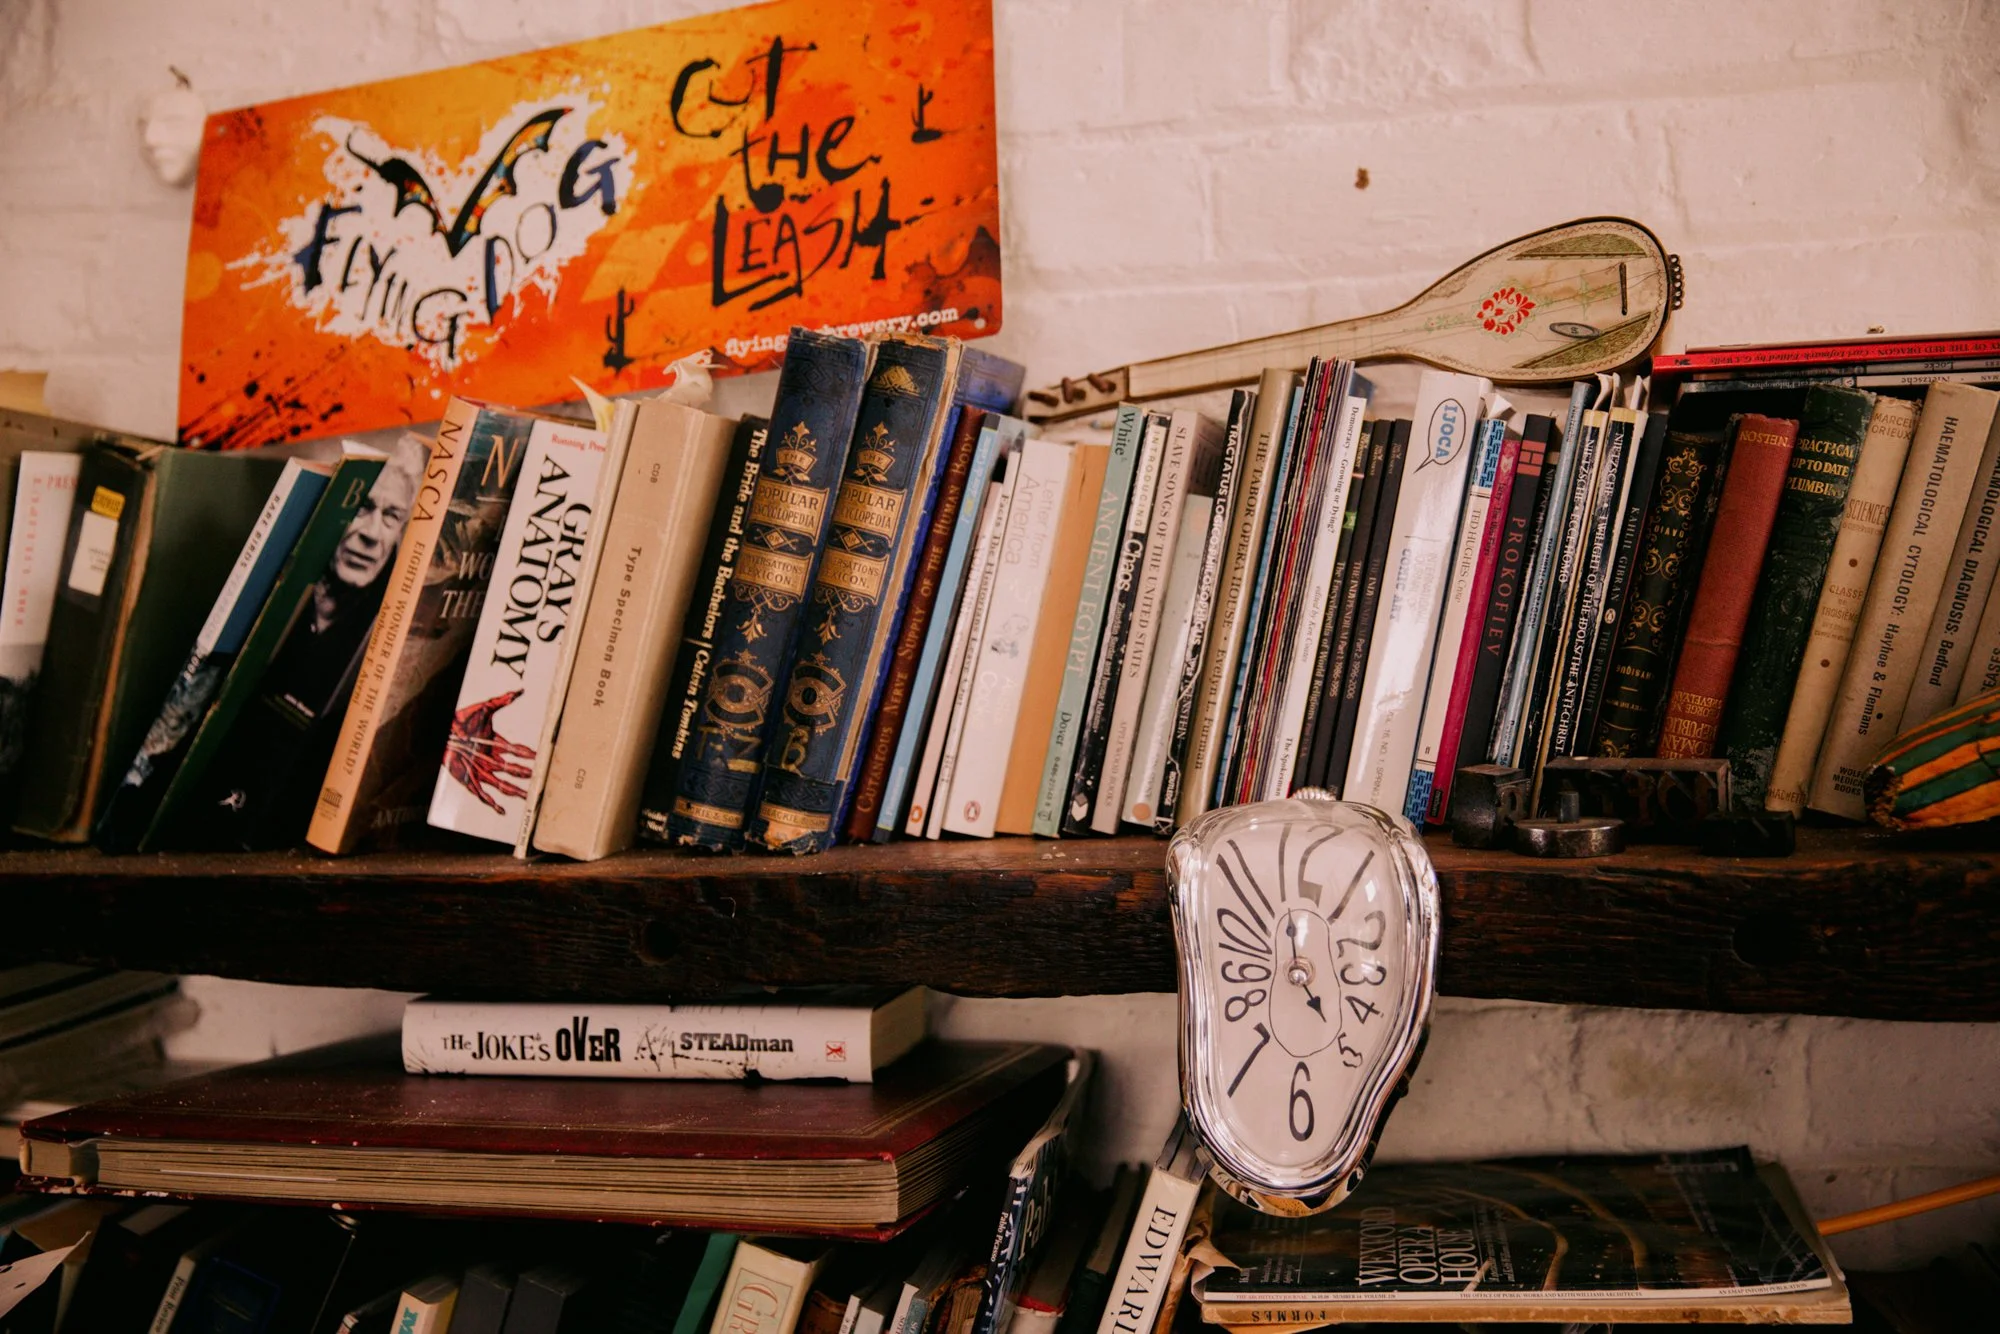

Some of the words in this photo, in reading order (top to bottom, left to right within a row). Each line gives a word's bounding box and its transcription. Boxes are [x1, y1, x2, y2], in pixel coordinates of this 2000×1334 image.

[1878, 346, 1921, 356] DRAGON
[1924, 360, 1955, 372] Locke
[1925, 344, 1945, 353] RED
[746, 425, 768, 459] The
[1112, 408, 1138, 457] White
[1168, 425, 1186, 468] SLAVE
[1254, 430, 1270, 463] THE
[1342, 405, 1360, 450] Democracy
[1435, 403, 1457, 460] IJOCA
[1738, 430, 1789, 447] NELSON
[411, 418, 463, 526] NASCA
[950, 432, 976, 476] BODY
[1217, 422, 1240, 495] TRACTATUS
[1333, 458, 1349, 493] Growing
[1573, 437, 1594, 502] NIETZSCHE
[1602, 431, 1624, 497] NIETZSCHE
[1807, 460, 1823, 472] TO
[1823, 462, 1849, 478] DATE
[1911, 414, 1959, 539] HAEMATOLOGICAL
[735, 459, 760, 503] Bride
[759, 485, 819, 511] POPULAR
[1133, 428, 1160, 526] INTRODUCING
[1159, 471, 1177, 518] SONGS
[1244, 465, 1264, 518] TABOR
[1332, 494, 1340, 503] or
[728, 504, 749, 534] and
[933, 482, 961, 537] HUMAN
[993, 493, 1010, 527] Facts
[1003, 471, 1042, 567] America
[1036, 476, 1060, 526] Letter
[1325, 504, 1340, 534] Dying?
[1469, 507, 1482, 530] TED
[1848, 499, 1890, 527] SCIENCES
[720, 535, 741, 563] the
[987, 533, 1001, 556] The
[1083, 488, 1119, 594] ANCIENT
[1155, 520, 1168, 539] OF
[1233, 521, 1253, 572] OPERA
[1565, 512, 1580, 542] ECCE
[1588, 513, 1608, 570] TWILIGHT
[1621, 505, 1641, 551] KAHLIL
[399, 540, 425, 594] EIGHTH
[490, 454, 571, 679] ANATOMY
[620, 544, 643, 582] Type
[925, 544, 943, 573] THE
[1027, 530, 1050, 570] from
[1116, 537, 1144, 593] Chaos
[1147, 542, 1164, 573] THE
[1333, 559, 1345, 577] The
[1394, 546, 1414, 591] COMIC
[1458, 531, 1477, 578] HUGHES
[1557, 542, 1574, 583] HOMO
[918, 579, 933, 597] OF
[1311, 585, 1322, 607] edited
[1484, 515, 1527, 657] PROKOFIEV
[1585, 572, 1597, 588] OF
[1609, 554, 1628, 602] GIBRAN
[1829, 584, 1865, 600] CLASSE
[1889, 543, 1922, 619] CYTOLOGY:
[1942, 557, 1979, 636] DIAGNOSIS:
[602, 586, 631, 662] Specimen
[700, 563, 734, 641] Bachelors
[1137, 575, 1157, 628] UNITED
[1221, 575, 1243, 629] HOUSE
[1307, 608, 1318, 619] by
[1320, 577, 1342, 637] Encyclopedia
[1579, 591, 1595, 616] THE
[364, 600, 391, 654] Anthony
[378, 598, 407, 660] WONDER
[897, 607, 925, 661] SUPPLY
[1066, 599, 1097, 677] EGYPT
[1306, 620, 1316, 636] Ken
[1319, 638, 1330, 650] of
[1597, 630, 1611, 653] THE
[1874, 620, 1901, 669] Hayhoe
[371, 662, 385, 682] OF
[685, 647, 710, 696] Calvin
[1127, 631, 1146, 679] STATES
[1205, 647, 1227, 697] Evelyn
[1313, 649, 1328, 681] World
[1871, 670, 1887, 684] &
[1927, 638, 1955, 687] Bedford
[361, 686, 378, 713] THE
[592, 667, 611, 708] Book
[883, 670, 908, 717] NERVE
[1304, 680, 1322, 720] Religions
[1344, 659, 1360, 700] 1996-2006
[1584, 657, 1604, 713] PROPHET
[670, 697, 698, 760] Tomkins
[1053, 710, 1073, 746] Dover
[1204, 699, 1217, 714] L.
[1553, 678, 1577, 752] ANTI-CHRIST
[1855, 684, 1883, 738] Flemans
[340, 717, 368, 776] WORLD?
[1192, 716, 1214, 771] Furman
[1282, 735, 1294, 751] The
[854, 724, 893, 814] CUTANEOUS
[1163, 769, 1177, 805] ROUTLEDGE
[1272, 751, 1290, 797] Spokesman
[1834, 785, 1862, 796] BOOKS
[1279, 822, 1344, 908] 12
[1327, 850, 1375, 925] 1
[1217, 908, 1273, 962] 10
[1336, 910, 1386, 958] 2
[1221, 960, 1272, 984] 9
[1341, 963, 1387, 987] 3
[1224, 988, 1267, 1023] 8
[1345, 995, 1382, 1025] 4
[555, 1016, 622, 1063] OVER
[679, 1031, 794, 1054] STEADman
[1227, 1022, 1271, 1098] 7
[1337, 1031, 1363, 1069] 5
[1288, 1060, 1315, 1142] 6
[995, 1210, 1009, 1234] Pablo
[988, 1232, 1003, 1263] Picasso
[1359, 1206, 1398, 1286] WEXFORD
[1399, 1224, 1438, 1285] OPERA
[1437, 1228, 1478, 1286] HOUSE
[1250, 1308, 1326, 1323] FORMES
